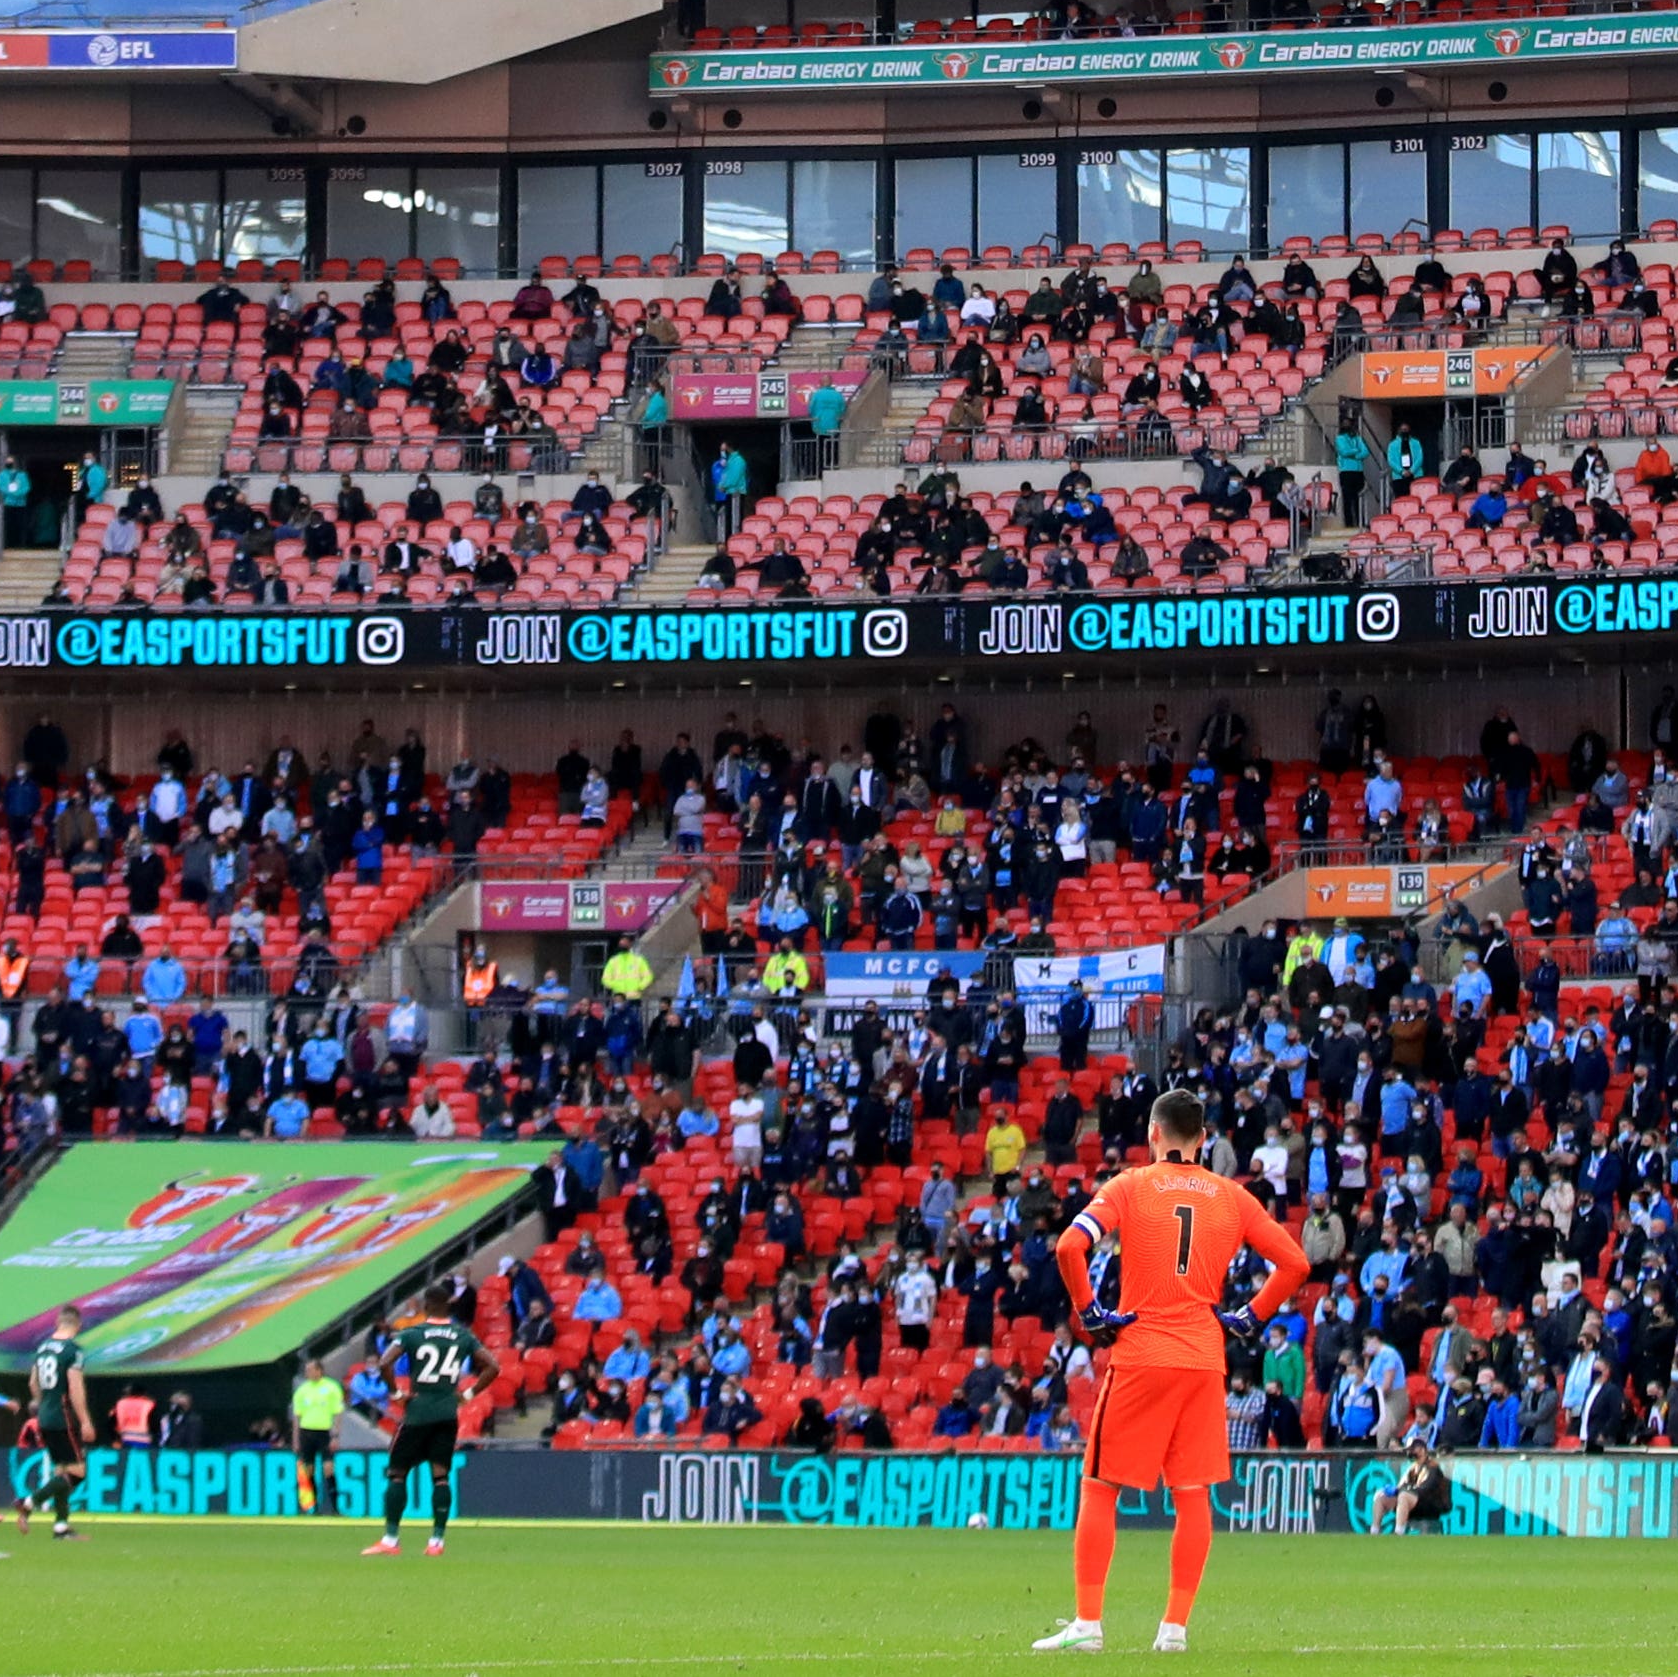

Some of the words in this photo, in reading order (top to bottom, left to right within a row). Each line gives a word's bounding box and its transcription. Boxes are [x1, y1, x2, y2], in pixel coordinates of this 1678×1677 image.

[1535, 28, 1626, 48] Carabao
[121, 42, 154, 58] EFL
[1260, 42, 1352, 61] Carabao
[1357, 41, 1423, 58] ENERGY
[1427, 38, 1476, 55] DRINK
[983, 54, 1076, 72] Carabao
[1080, 54, 1146, 70] ENERGY
[1150, 51, 1200, 67] DRINK
[703, 62, 796, 80] Carabao
[801, 63, 868, 78] ENERGY
[872, 62, 923, 77] DRINK
[1395, 139, 1423, 152] 3101
[1452, 136, 1483, 149] 3102
[1021, 153, 1055, 166] 3099
[1080, 151, 1113, 164] 3100
[270, 169, 304, 180] 3095
[329, 168, 365, 180] 3096
[647, 163, 682, 176] 3097
[706, 162, 742, 174] 3098
[1449, 358, 1471, 370] 246
[61, 389, 84, 401] 244
[762, 384, 784, 395] 245
[1469, 587, 1547, 638] JOIN
[980, 605, 1061, 654] JOIN
[1069, 596, 1349, 650] @EASPORTSFUT
[57, 619, 350, 664] @EASPORTSFUT
[477, 615, 560, 665] JOIN
[568, 612, 855, 661] @EASPORTSFUT
[1400, 875, 1422, 888] 139
[575, 891, 598, 903] 138
[1153, 1175, 1219, 1197] LLORIS
[1174, 1203, 1194, 1277] 1
[416, 1344, 460, 1384] 24
[643, 1455, 759, 1523] JOIN
